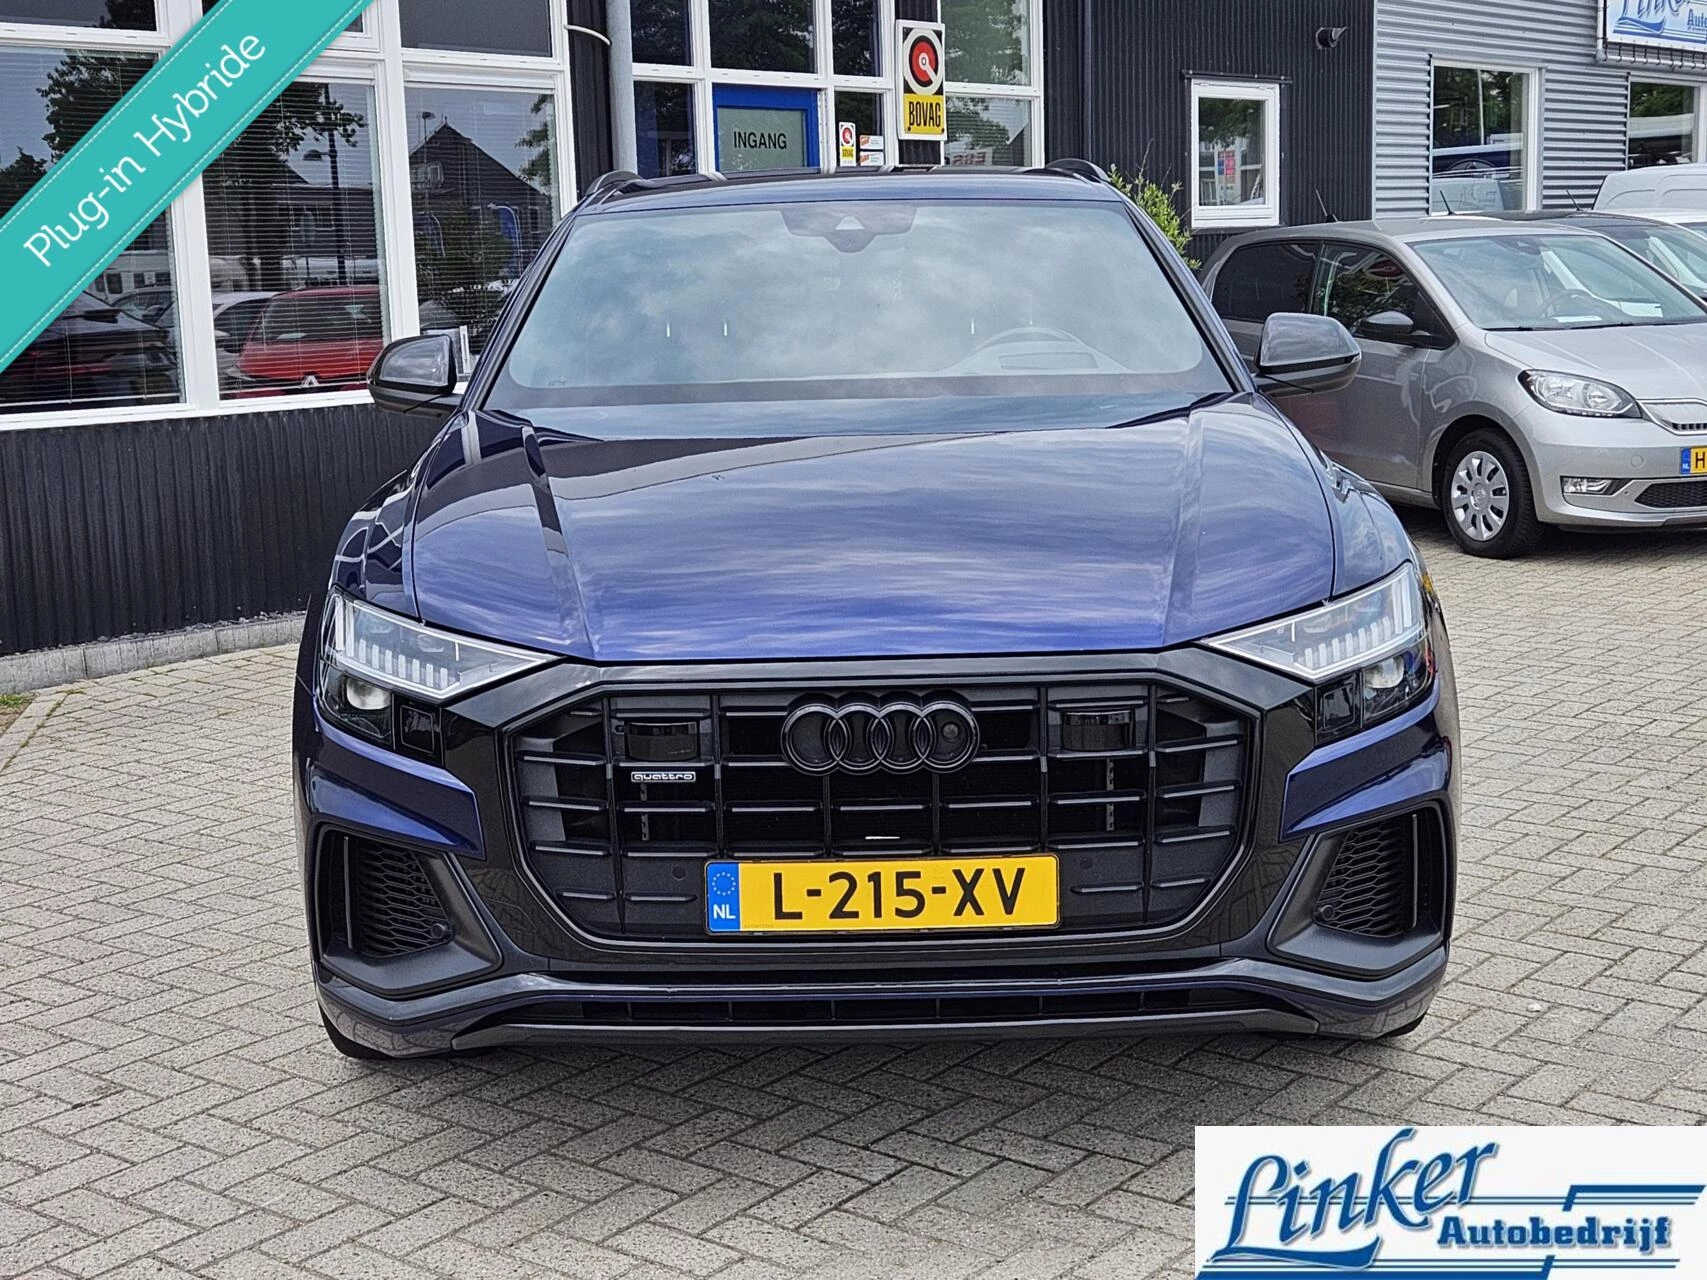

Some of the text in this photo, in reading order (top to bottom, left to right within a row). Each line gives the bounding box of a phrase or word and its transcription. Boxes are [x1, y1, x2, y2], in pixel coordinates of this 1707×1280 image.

[908, 101, 941, 127] BOVAG
[733, 131, 787, 149] INGANG
[633, 773, 693, 781] quattro
[773, 867, 1026, 921] L-215-XV
[713, 904, 736, 920] NL
